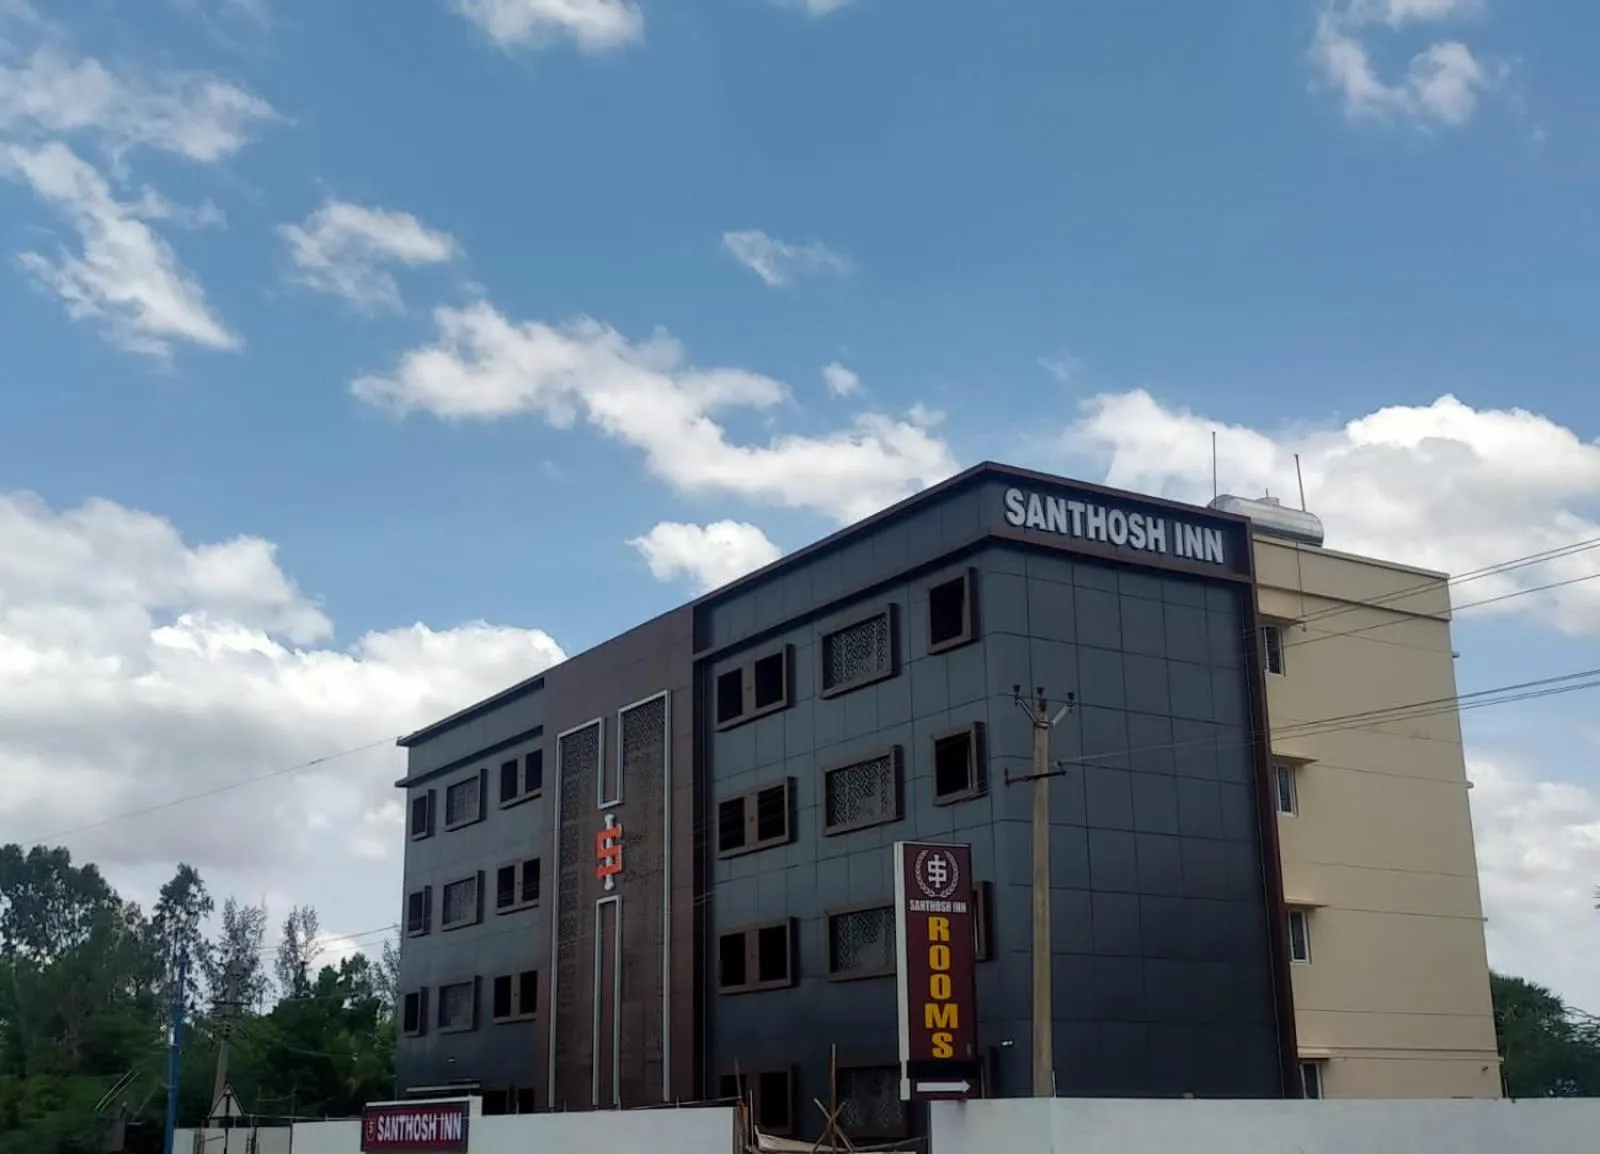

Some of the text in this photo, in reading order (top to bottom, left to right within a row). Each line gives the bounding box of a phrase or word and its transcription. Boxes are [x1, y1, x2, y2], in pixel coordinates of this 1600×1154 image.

[1004, 488, 1224, 563] SANTHOSH INN
[909, 899, 967, 913] SANTHOSH INN
[924, 916, 959, 1059] ROOMS
[377, 1111, 462, 1142] SANTHOSH INN
